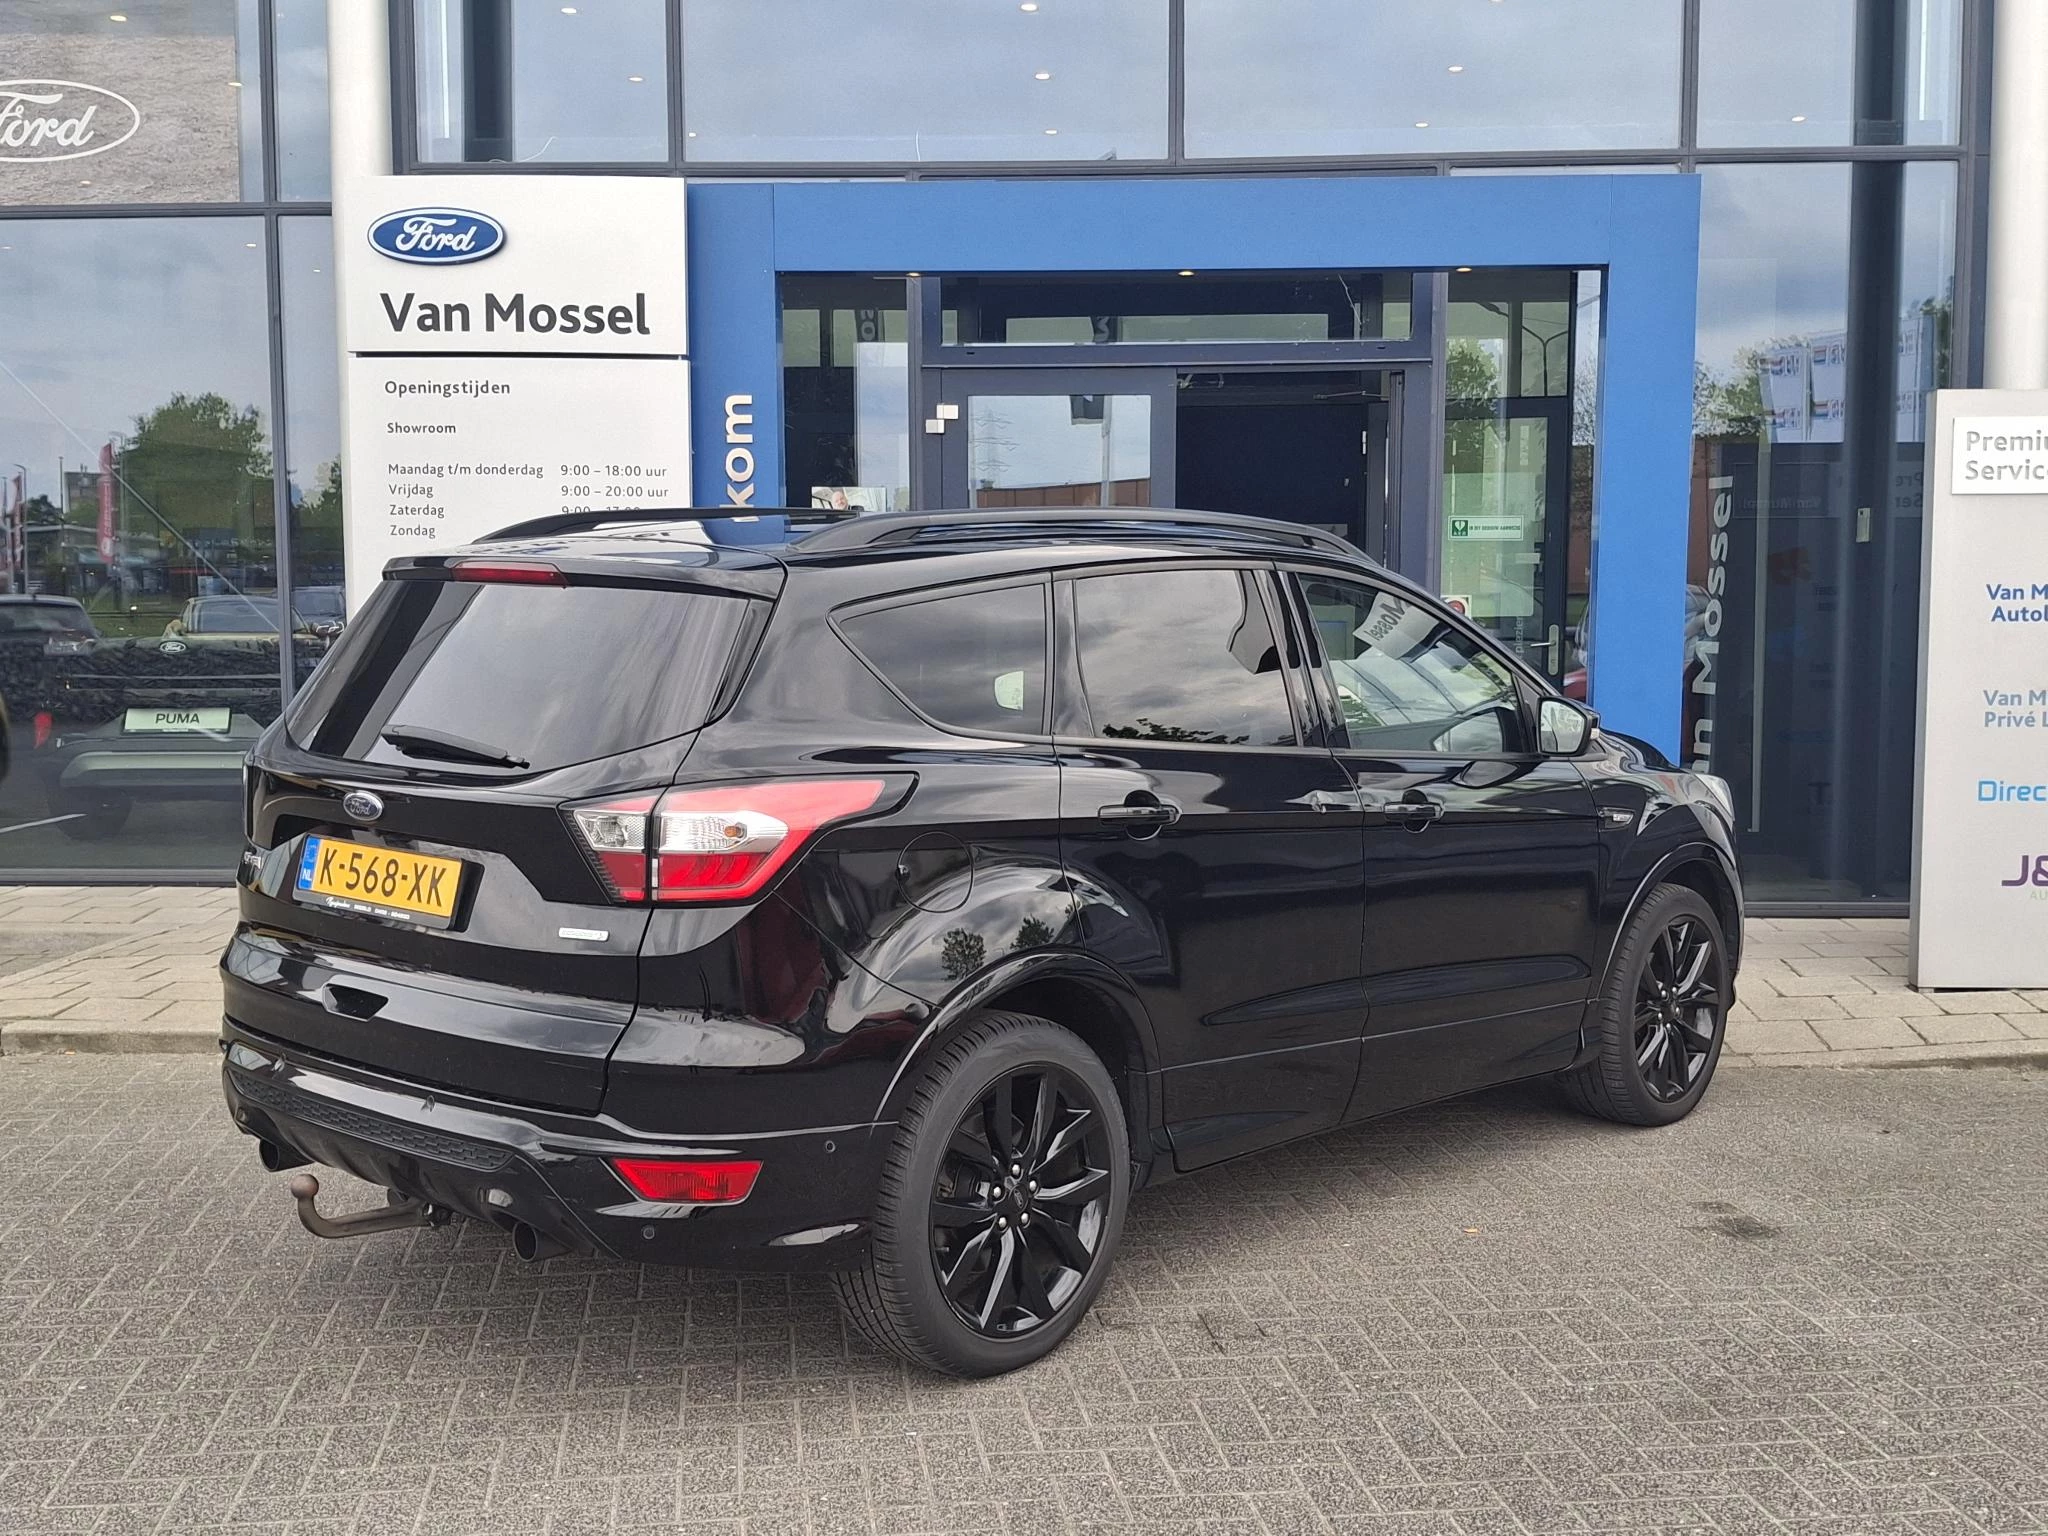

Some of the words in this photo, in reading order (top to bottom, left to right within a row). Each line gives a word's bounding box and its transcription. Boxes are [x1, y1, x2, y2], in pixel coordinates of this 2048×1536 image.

[0, 91, 98, 147] Ford
[395, 216, 477, 252] Ford
[380, 293, 470, 332] Van
[485, 293, 650, 335] Mossel
[385, 380, 511, 397] Openingstijden
[387, 422, 456, 434] Showroom
[1966, 429, 2048, 452] Premi
[388, 463, 444, 478] Maandag
[448, 463, 471, 476] t/m
[475, 463, 544, 479] donderdag
[560, 464, 590, 476] 9:00
[605, 465, 641, 477] 18:00
[645, 468, 668, 477] uur
[1965, 458, 2048, 481] Servic
[389, 484, 434, 498] Vrijdag
[561, 485, 590, 497] 9:00
[605, 486, 643, 497] 20:00
[647, 489, 669, 497] uur
[389, 504, 445, 518] Zaterdag
[390, 525, 436, 539] Zondag
[1692, 475, 1734, 696] Mossel
[1985, 584, 2025, 600] Van
[1983, 689, 2022, 706] Van
[155, 713, 200, 724] PUMA
[1984, 710, 2036, 728] Privé
[301, 868, 312, 881] NL
[319, 848, 447, 907] K-568-XK
